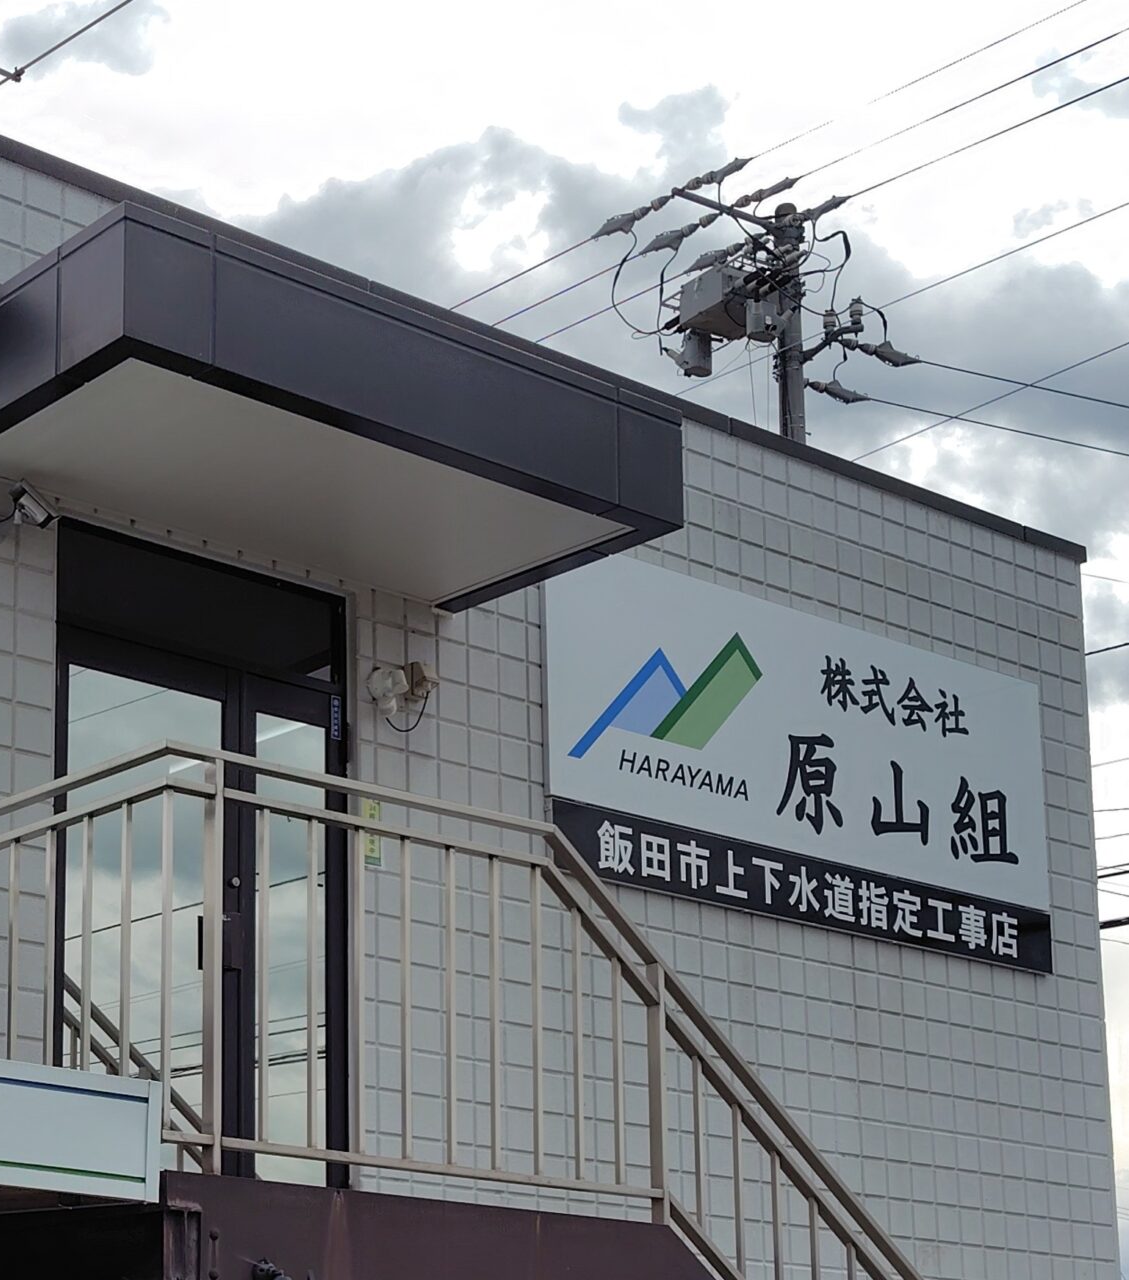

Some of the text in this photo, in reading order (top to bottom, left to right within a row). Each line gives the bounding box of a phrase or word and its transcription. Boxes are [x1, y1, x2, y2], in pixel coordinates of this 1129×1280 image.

[820, 655, 969, 737] 株式会社
[619, 749, 749, 801] HARAYAMA
[776, 733, 1019, 865] 原山組
[597, 820, 1019, 959] 飯田市上下水道指定工事店
